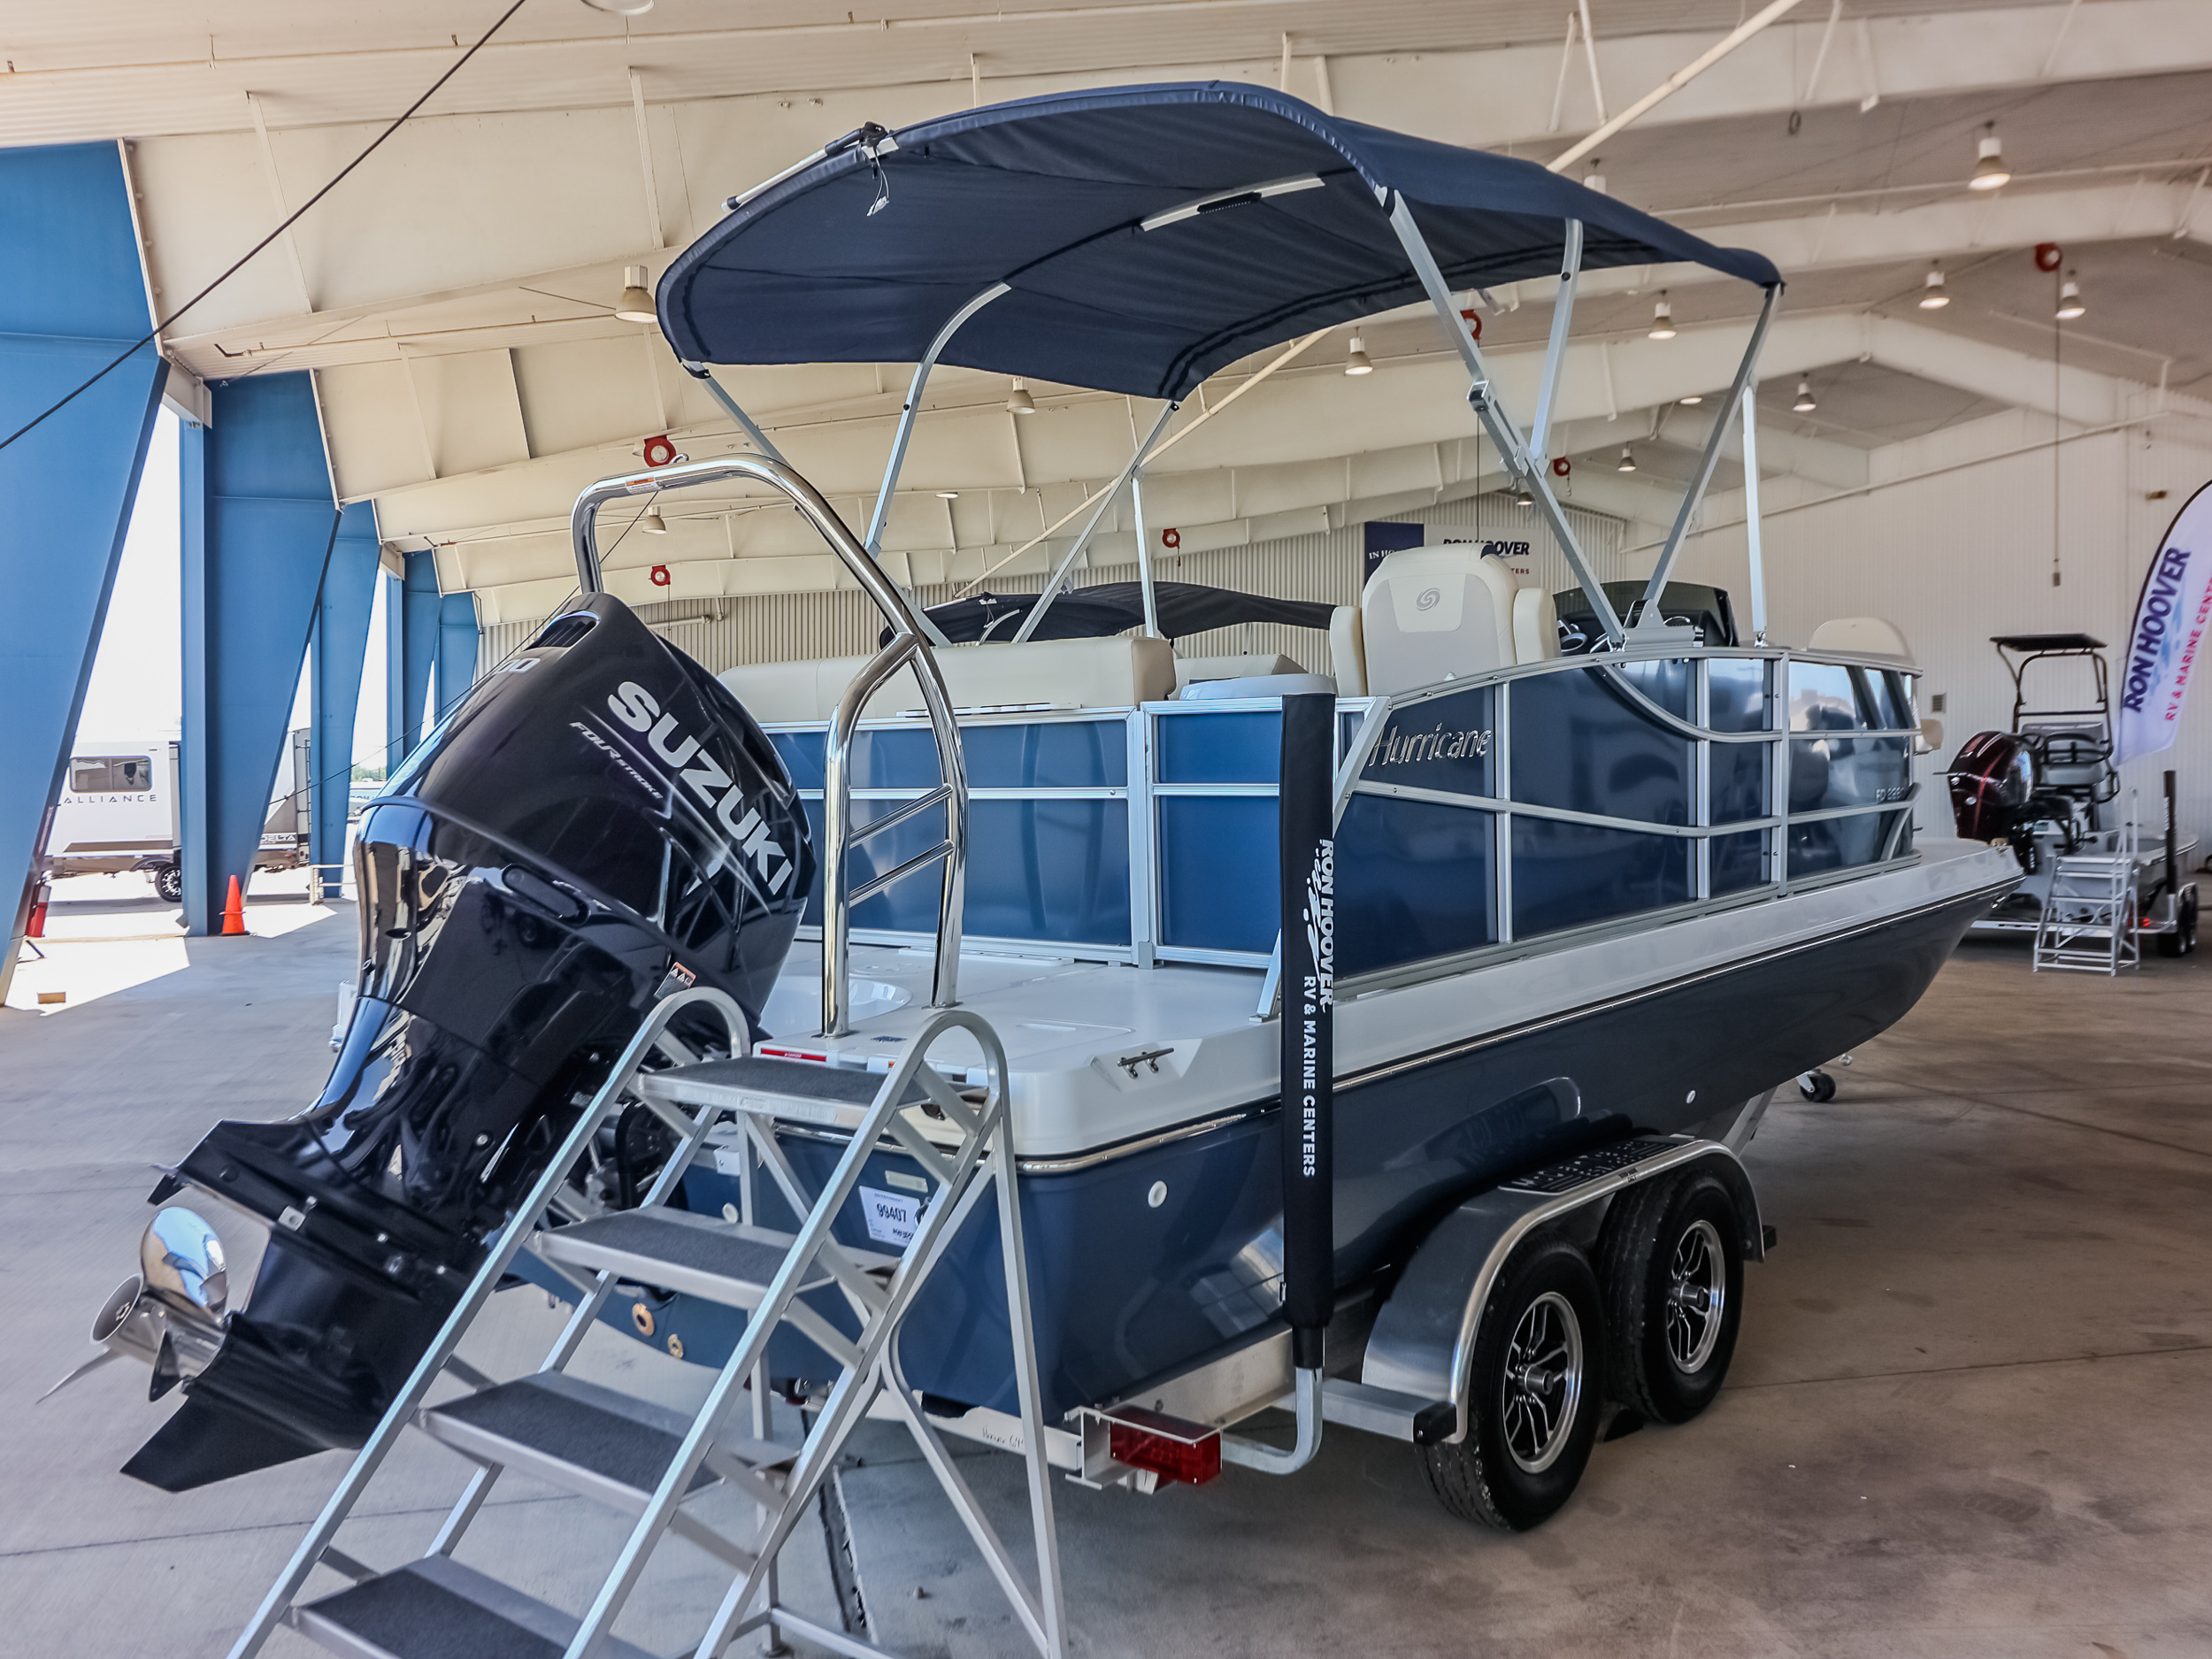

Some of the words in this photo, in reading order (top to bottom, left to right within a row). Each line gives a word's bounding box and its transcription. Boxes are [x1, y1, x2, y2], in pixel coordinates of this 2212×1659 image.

[2136, 547, 2192, 656] HOOVER
[2124, 655, 2156, 713] RON
[2165, 702, 2179, 721] RV
[2176, 629, 2202, 686] MARINE
[569, 721, 621, 759] FOUR
[618, 757, 664, 799] STROKE
[1368, 722, 1492, 767] Hurricane
[64, 795, 157, 803] ALLIANCE
[608, 680, 794, 896] SUZUKI
[1319, 839, 1334, 895] RON
[1303, 976, 1317, 999] RV
[1319, 899, 1334, 1013] HOOVER
[1303, 1003, 1317, 1015] &
[1303, 1020, 1317, 1089] MARINE
[1303, 1094, 1316, 1177] CENTERS
[876, 1203, 907, 1223] 99407
